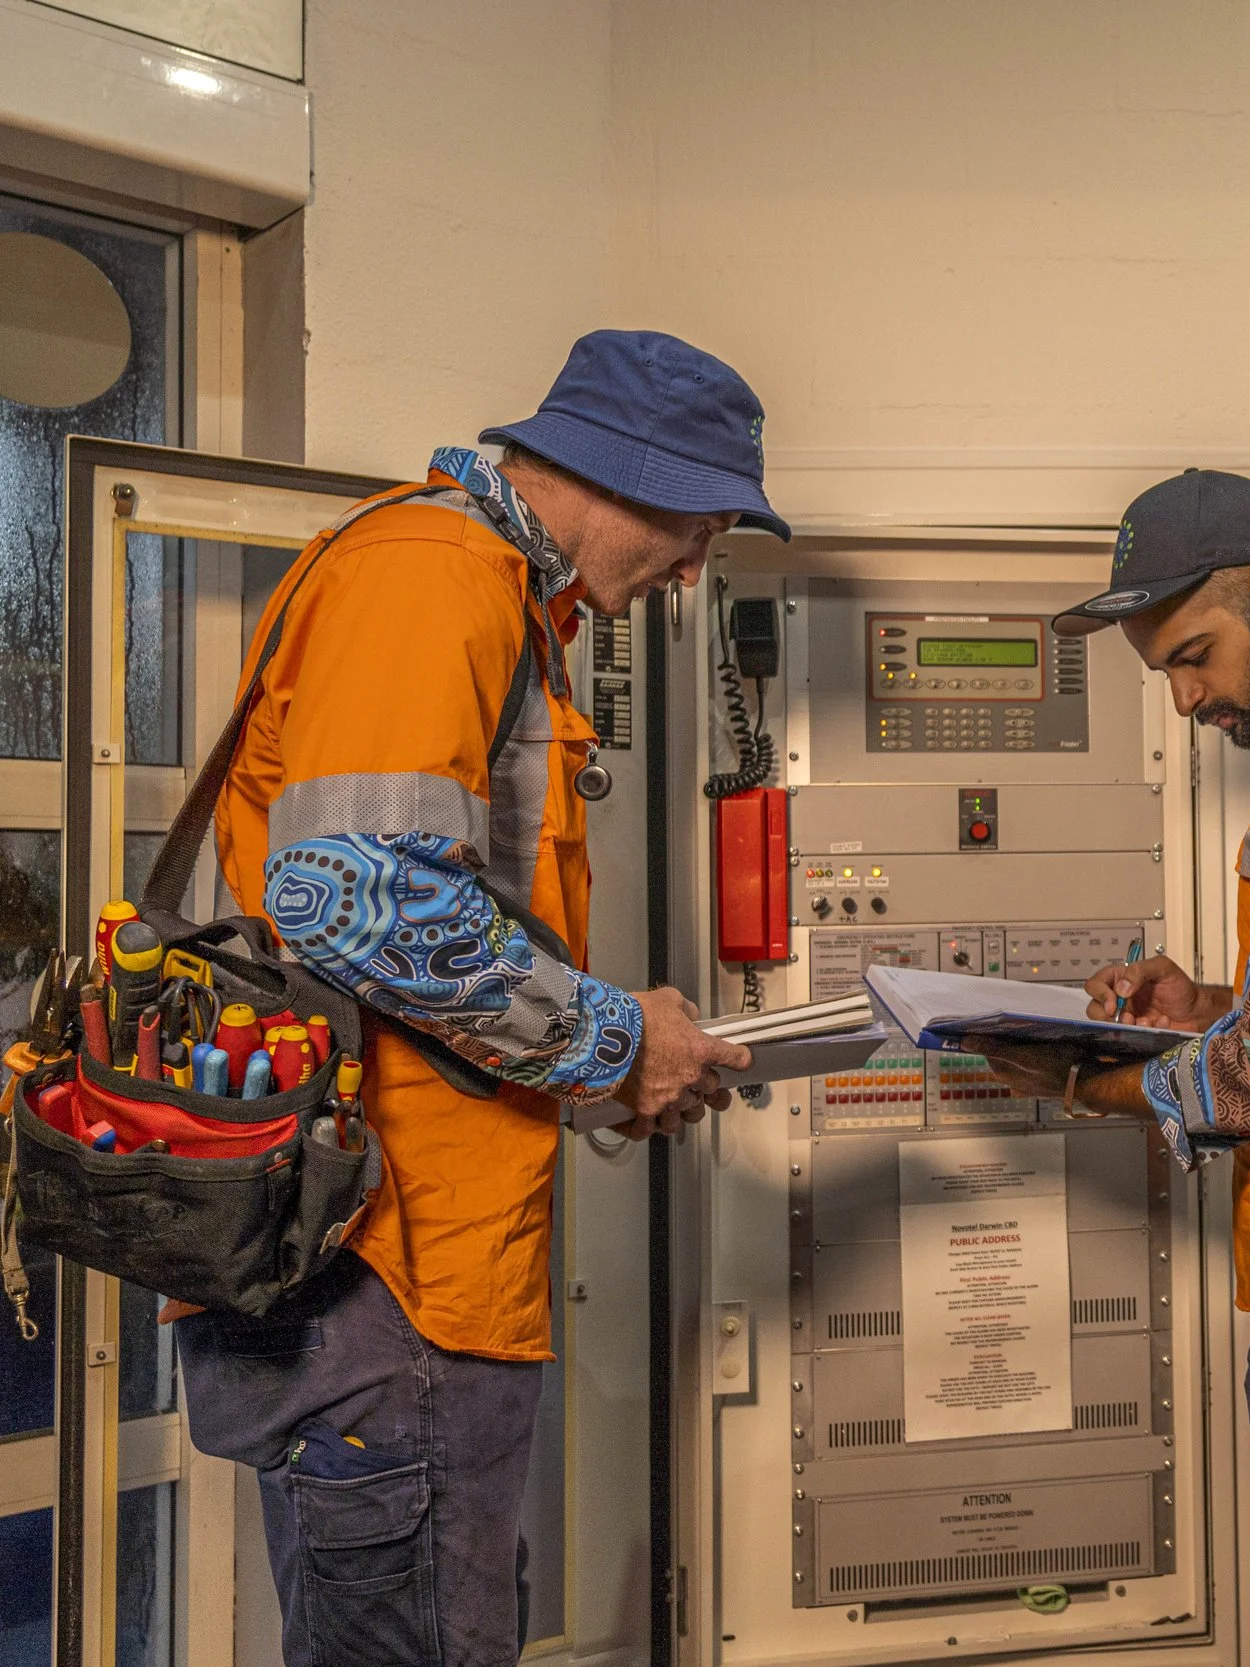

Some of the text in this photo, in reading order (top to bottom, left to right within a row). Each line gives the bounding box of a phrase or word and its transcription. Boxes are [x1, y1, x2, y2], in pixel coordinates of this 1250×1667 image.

[298, 1063, 311, 1084] iha
[952, 1221, 1018, 1233] Novotel Darwin CBD
[950, 1233, 1021, 1246] PUBLIC ADDRESS
[962, 1492, 1012, 1507] ATTENTION
[940, 1515, 962, 1523] SYSTEM
[988, 1511, 1016, 1519] POWERED
[1016, 1509, 1034, 1517] DOWN
